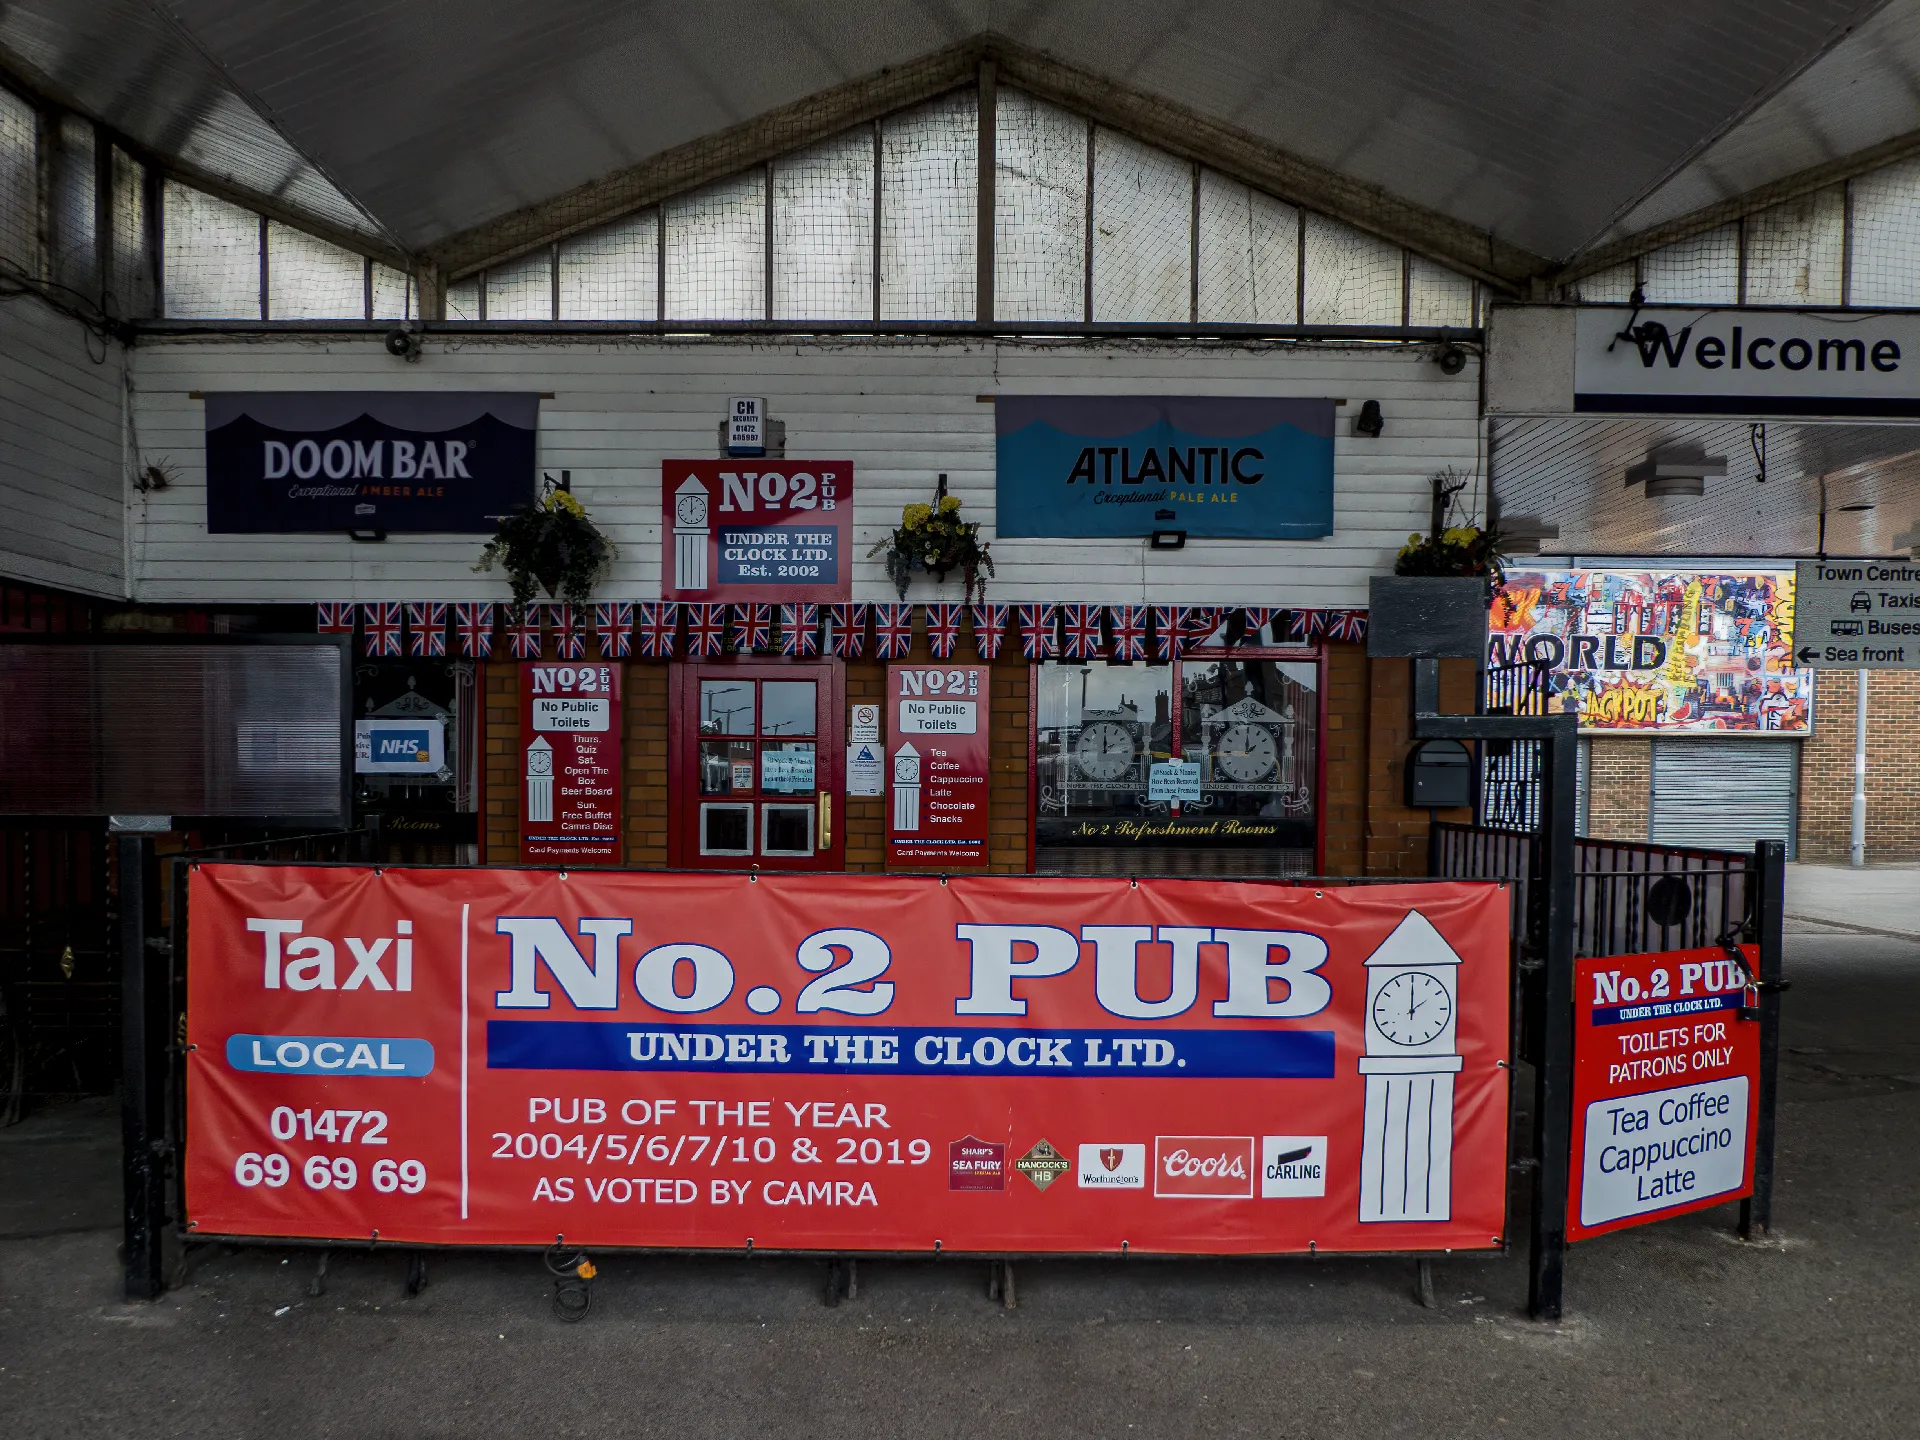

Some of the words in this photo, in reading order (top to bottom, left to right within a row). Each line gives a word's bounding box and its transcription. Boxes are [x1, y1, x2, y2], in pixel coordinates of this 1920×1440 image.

[1633, 326, 1901, 372] Welcome
[737, 401, 755, 415] CH
[736, 424, 755, 432] 01472
[262, 439, 385, 480] DOOM
[1066, 447, 1265, 485] ATLANTIC
[288, 484, 359, 499] Exceptional
[360, 486, 411, 497] AMBER
[416, 486, 445, 497] ALE
[821, 473, 836, 511] PUB
[1093, 489, 1167, 507] Exceptional
[1169, 492, 1204, 503] PALE
[1210, 492, 1238, 503] ALE
[725, 533, 789, 545] UNDER
[795, 533, 832, 545] THE
[724, 549, 786, 561] CLOCK
[791, 549, 833, 561] LTD.
[738, 564, 772, 577] Est.
[778, 565, 819, 577] 2002
[1815, 565, 1862, 581] Town
[1878, 593, 1920, 608] Taxis
[1868, 620, 1920, 635] Buses
[1488, 633, 1667, 671] WORLD
[1825, 647, 1858, 661] Sea
[1862, 647, 1905, 662] front
[968, 670, 978, 695] PUB
[541, 701, 558, 712] No
[561, 701, 599, 712] Public
[908, 704, 925, 714] No
[929, 704, 966, 715] Public
[550, 717, 590, 727] Toilets
[917, 719, 957, 730] Toilets
[573, 734, 602, 743] Thurs.
[380, 740, 419, 754] NHS
[576, 746, 597, 754] Quiz
[930, 748, 947, 757] Tea
[577, 756, 596, 764] Sat.
[930, 762, 960, 770] Coffee
[564, 767, 590, 776] Open
[591, 767, 609, 775] The
[578, 777, 596, 785] Box
[930, 775, 984, 784] Cappuccino
[585, 787, 613, 795] Board
[930, 789, 952, 797] Latte
[577, 801, 597, 809] Sun.
[930, 802, 976, 810] Chocolate
[585, 811, 612, 819] Buffet
[930, 815, 963, 823] Snacks
[387, 815, 443, 831] Rooms
[1072, 821, 1098, 836] No
[1100, 823, 1110, 835] 2
[1115, 820, 1219, 840] Refreshment
[1221, 819, 1278, 835] Rooms
[547, 846, 580, 854] Payments
[246, 917, 413, 992] Taxi
[495, 915, 895, 1016] No.2
[954, 923, 1333, 1020] PUB
[1592, 968, 1670, 1005] No.2
[1679, 959, 1746, 995] PUB
[1619, 1006, 1651, 1020] UNDER
[1652, 1003, 1672, 1016] THE
[1673, 1000, 1703, 1014] CLOCK
[1704, 997, 1723, 1010] LTD.
[1618, 1027, 1689, 1055] TOILETS
[1694, 1022, 1726, 1044] FOR
[252, 1041, 406, 1070] LOCAL
[626, 1032, 792, 1064] UNDER
[803, 1035, 899, 1065] THE
[914, 1035, 1072, 1067] CLOCK
[1084, 1038, 1187, 1068] LTD.
[1609, 1054, 1687, 1084] PATRONS
[1692, 1046, 1734, 1069] ONLY
[529, 1096, 607, 1124] PUB
[621, 1098, 677, 1126] OF
[689, 1099, 771, 1127] THE
[784, 1101, 891, 1129] YEAR
[1606, 1107, 1649, 1136] Tea
[1658, 1092, 1730, 1126] Coffee
[270, 1105, 388, 1145] 01472
[491, 1132, 777, 1167] 2004/5/6/7/10
[791, 1137, 823, 1164] &
[836, 1137, 931, 1165] 2019
[961, 1147, 994, 1156] SHARP'S
[1599, 1127, 1732, 1175] Cappuccino
[952, 1160, 973, 1170] SEA
[974, 1160, 1001, 1170] FURY
[1017, 1161, 1068, 1170] HANCOCK'S
[1162, 1148, 1245, 1178] Coors
[234, 1152, 290, 1187] 69
[303, 1155, 358, 1190] 69
[372, 1159, 427, 1194] 69
[1034, 1170, 1052, 1181] HB
[1083, 1173, 1139, 1185] Worthington's
[1266, 1165, 1321, 1180] CARLING
[531, 1176, 575, 1202] AS
[584, 1177, 698, 1204] VOTED
[710, 1179, 752, 1205] BY
[763, 1180, 878, 1206] CAMRA
[1637, 1168, 1696, 1202] Latte
